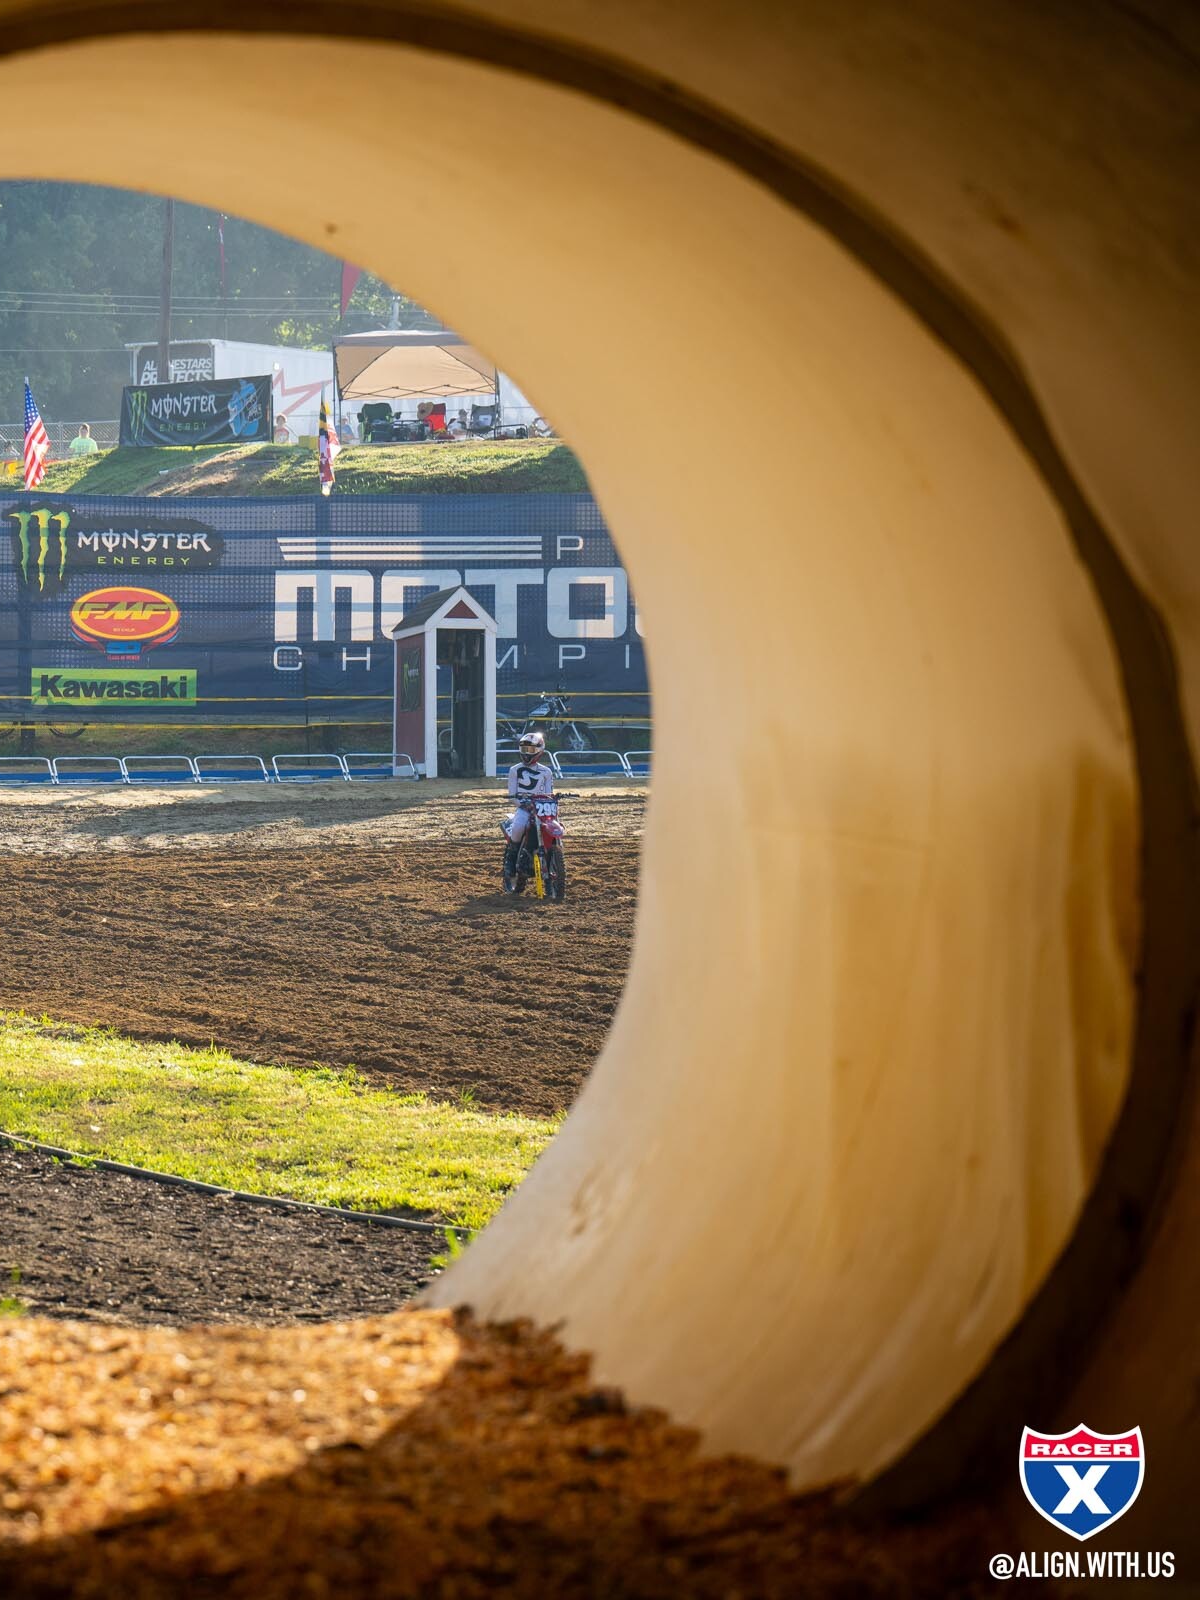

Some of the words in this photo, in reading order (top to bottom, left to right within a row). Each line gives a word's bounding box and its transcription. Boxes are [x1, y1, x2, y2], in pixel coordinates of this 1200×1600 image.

[143, 358, 213, 372] ALNESTARS
[151, 392, 217, 419] MONSTER
[159, 421, 208, 433] ENERGY
[77, 528, 211, 553] MONSTER
[98, 556, 190, 566] ENERGY
[79, 602, 170, 620] FMF
[40, 674, 188, 699] Kawasaki
